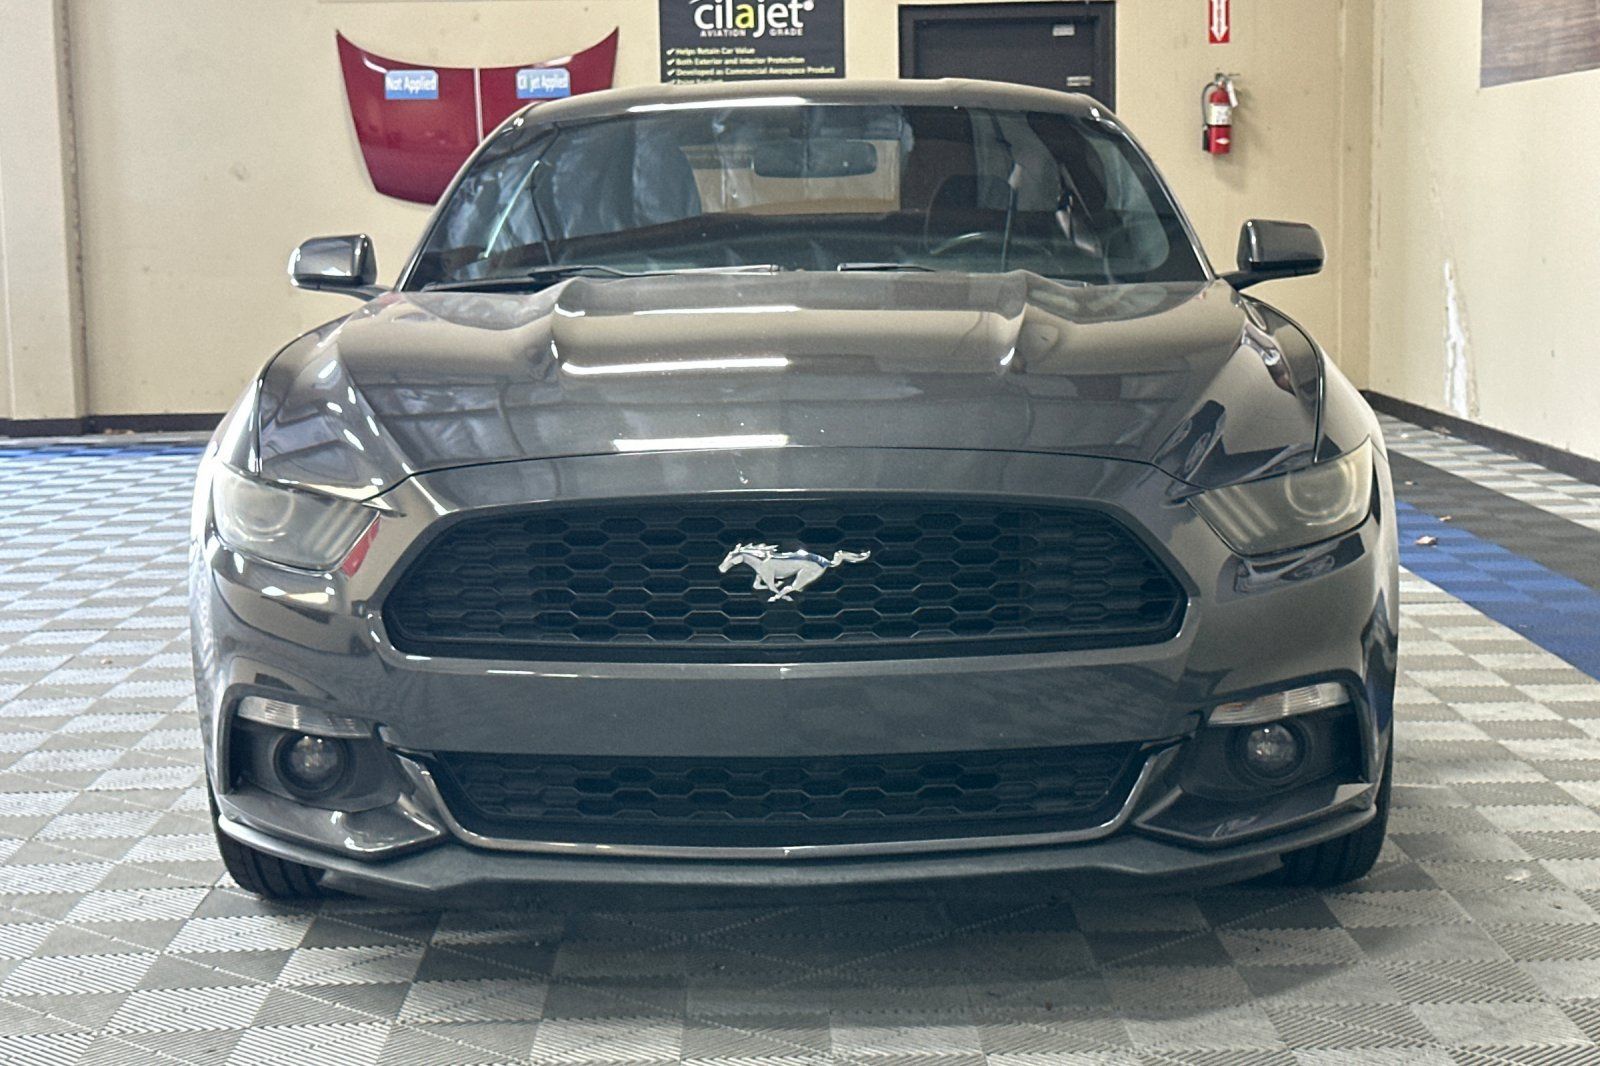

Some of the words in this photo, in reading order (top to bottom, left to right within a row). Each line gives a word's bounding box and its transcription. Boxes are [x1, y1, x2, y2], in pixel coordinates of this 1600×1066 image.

[694, 0, 804, 38] cilajet
[700, 29, 747, 37] AVIATION
[769, 28, 804, 36] GRADE
